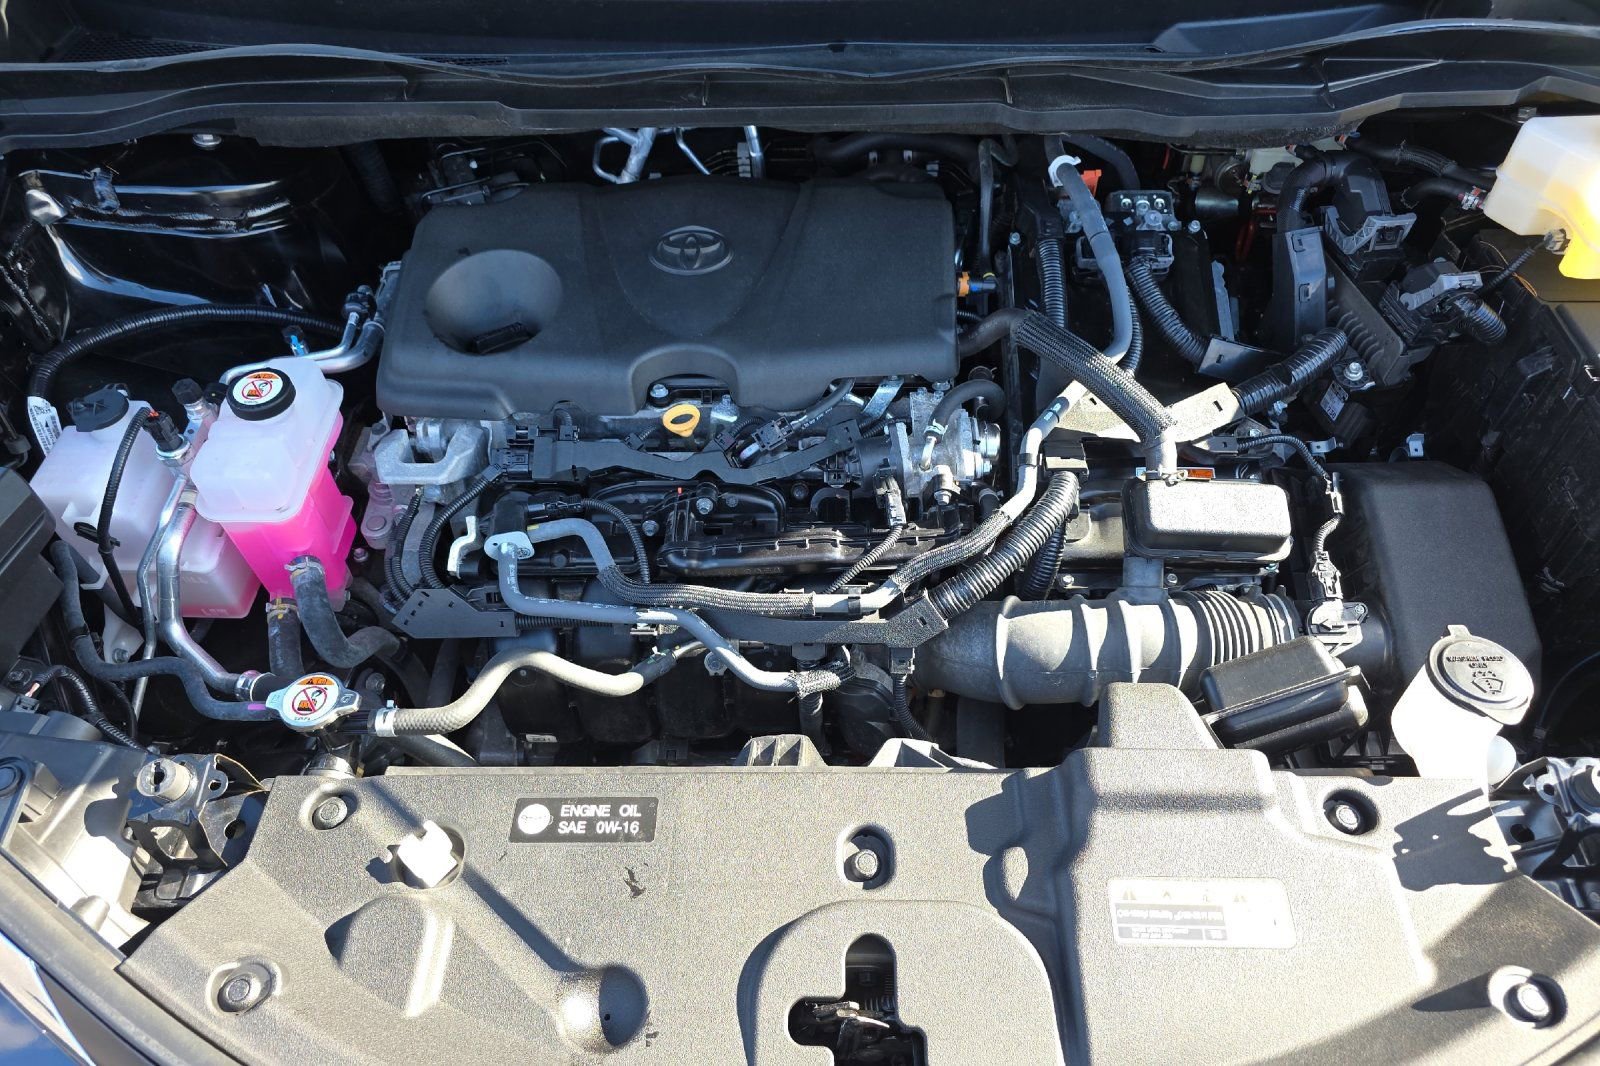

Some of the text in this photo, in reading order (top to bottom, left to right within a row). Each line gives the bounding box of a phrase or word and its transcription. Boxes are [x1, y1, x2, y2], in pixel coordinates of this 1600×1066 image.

[560, 804, 642, 817] ENGINE OIL
[557, 821, 640, 834] SAE 0W-16
